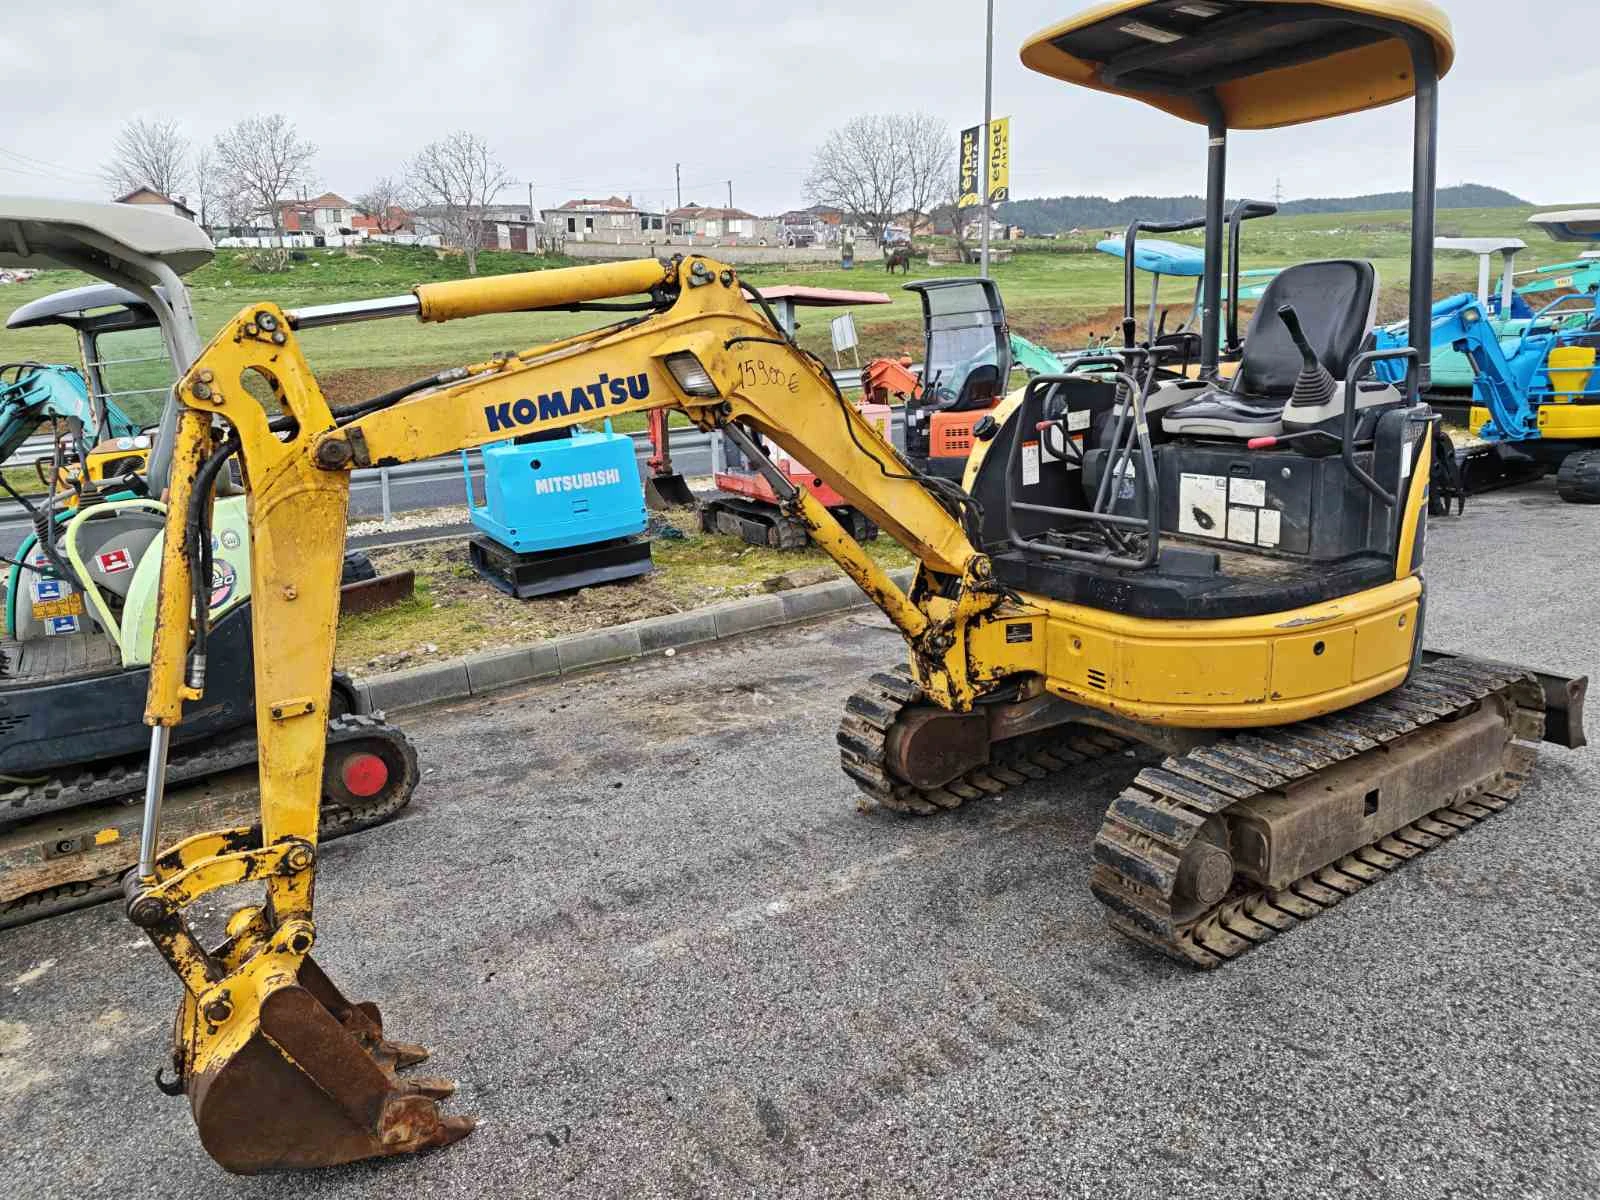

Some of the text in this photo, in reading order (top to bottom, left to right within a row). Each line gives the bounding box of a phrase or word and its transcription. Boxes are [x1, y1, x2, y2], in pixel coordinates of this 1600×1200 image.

[992, 125, 1002, 181] efbet
[484, 373, 650, 432] KOMATSU
[534, 468, 621, 495] MITSUBISHI
